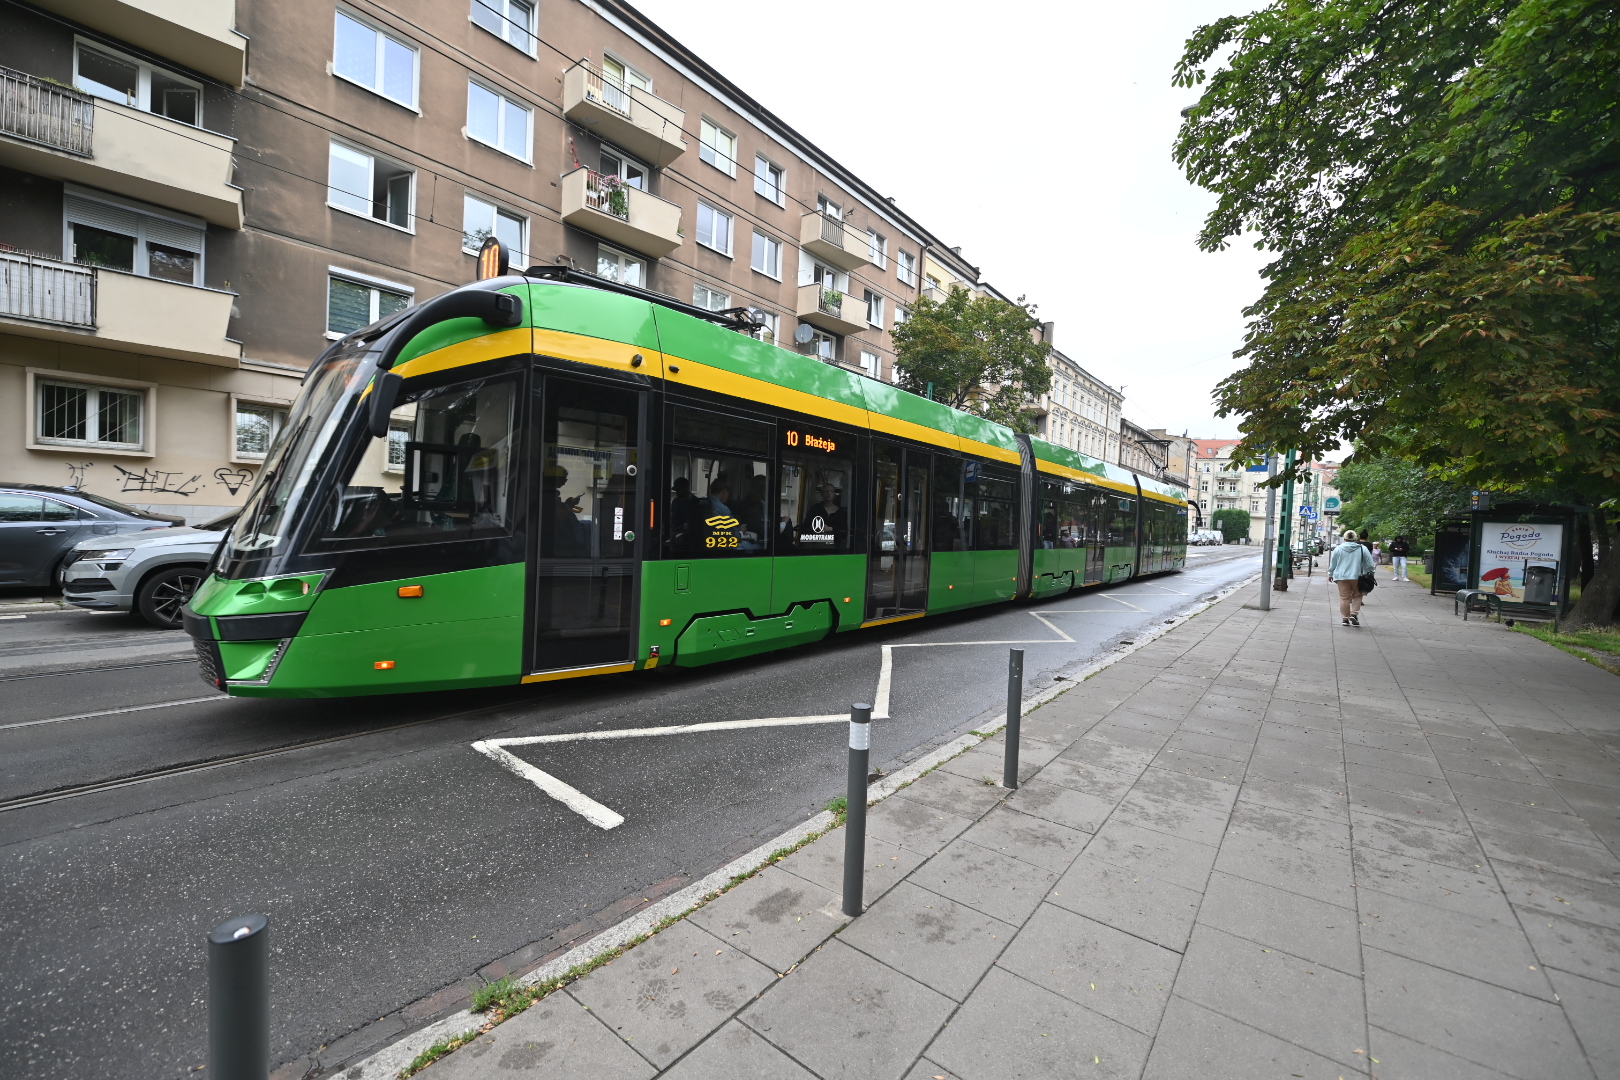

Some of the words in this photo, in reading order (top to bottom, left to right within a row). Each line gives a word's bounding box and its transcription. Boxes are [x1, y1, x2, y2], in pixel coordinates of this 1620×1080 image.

[482, 244, 499, 280] 10
[786, 430, 798, 447] 10
[805, 434, 836, 453] Błażeja
[705, 536, 738, 548] 922
[1500, 530, 1541, 541] Pogoda
